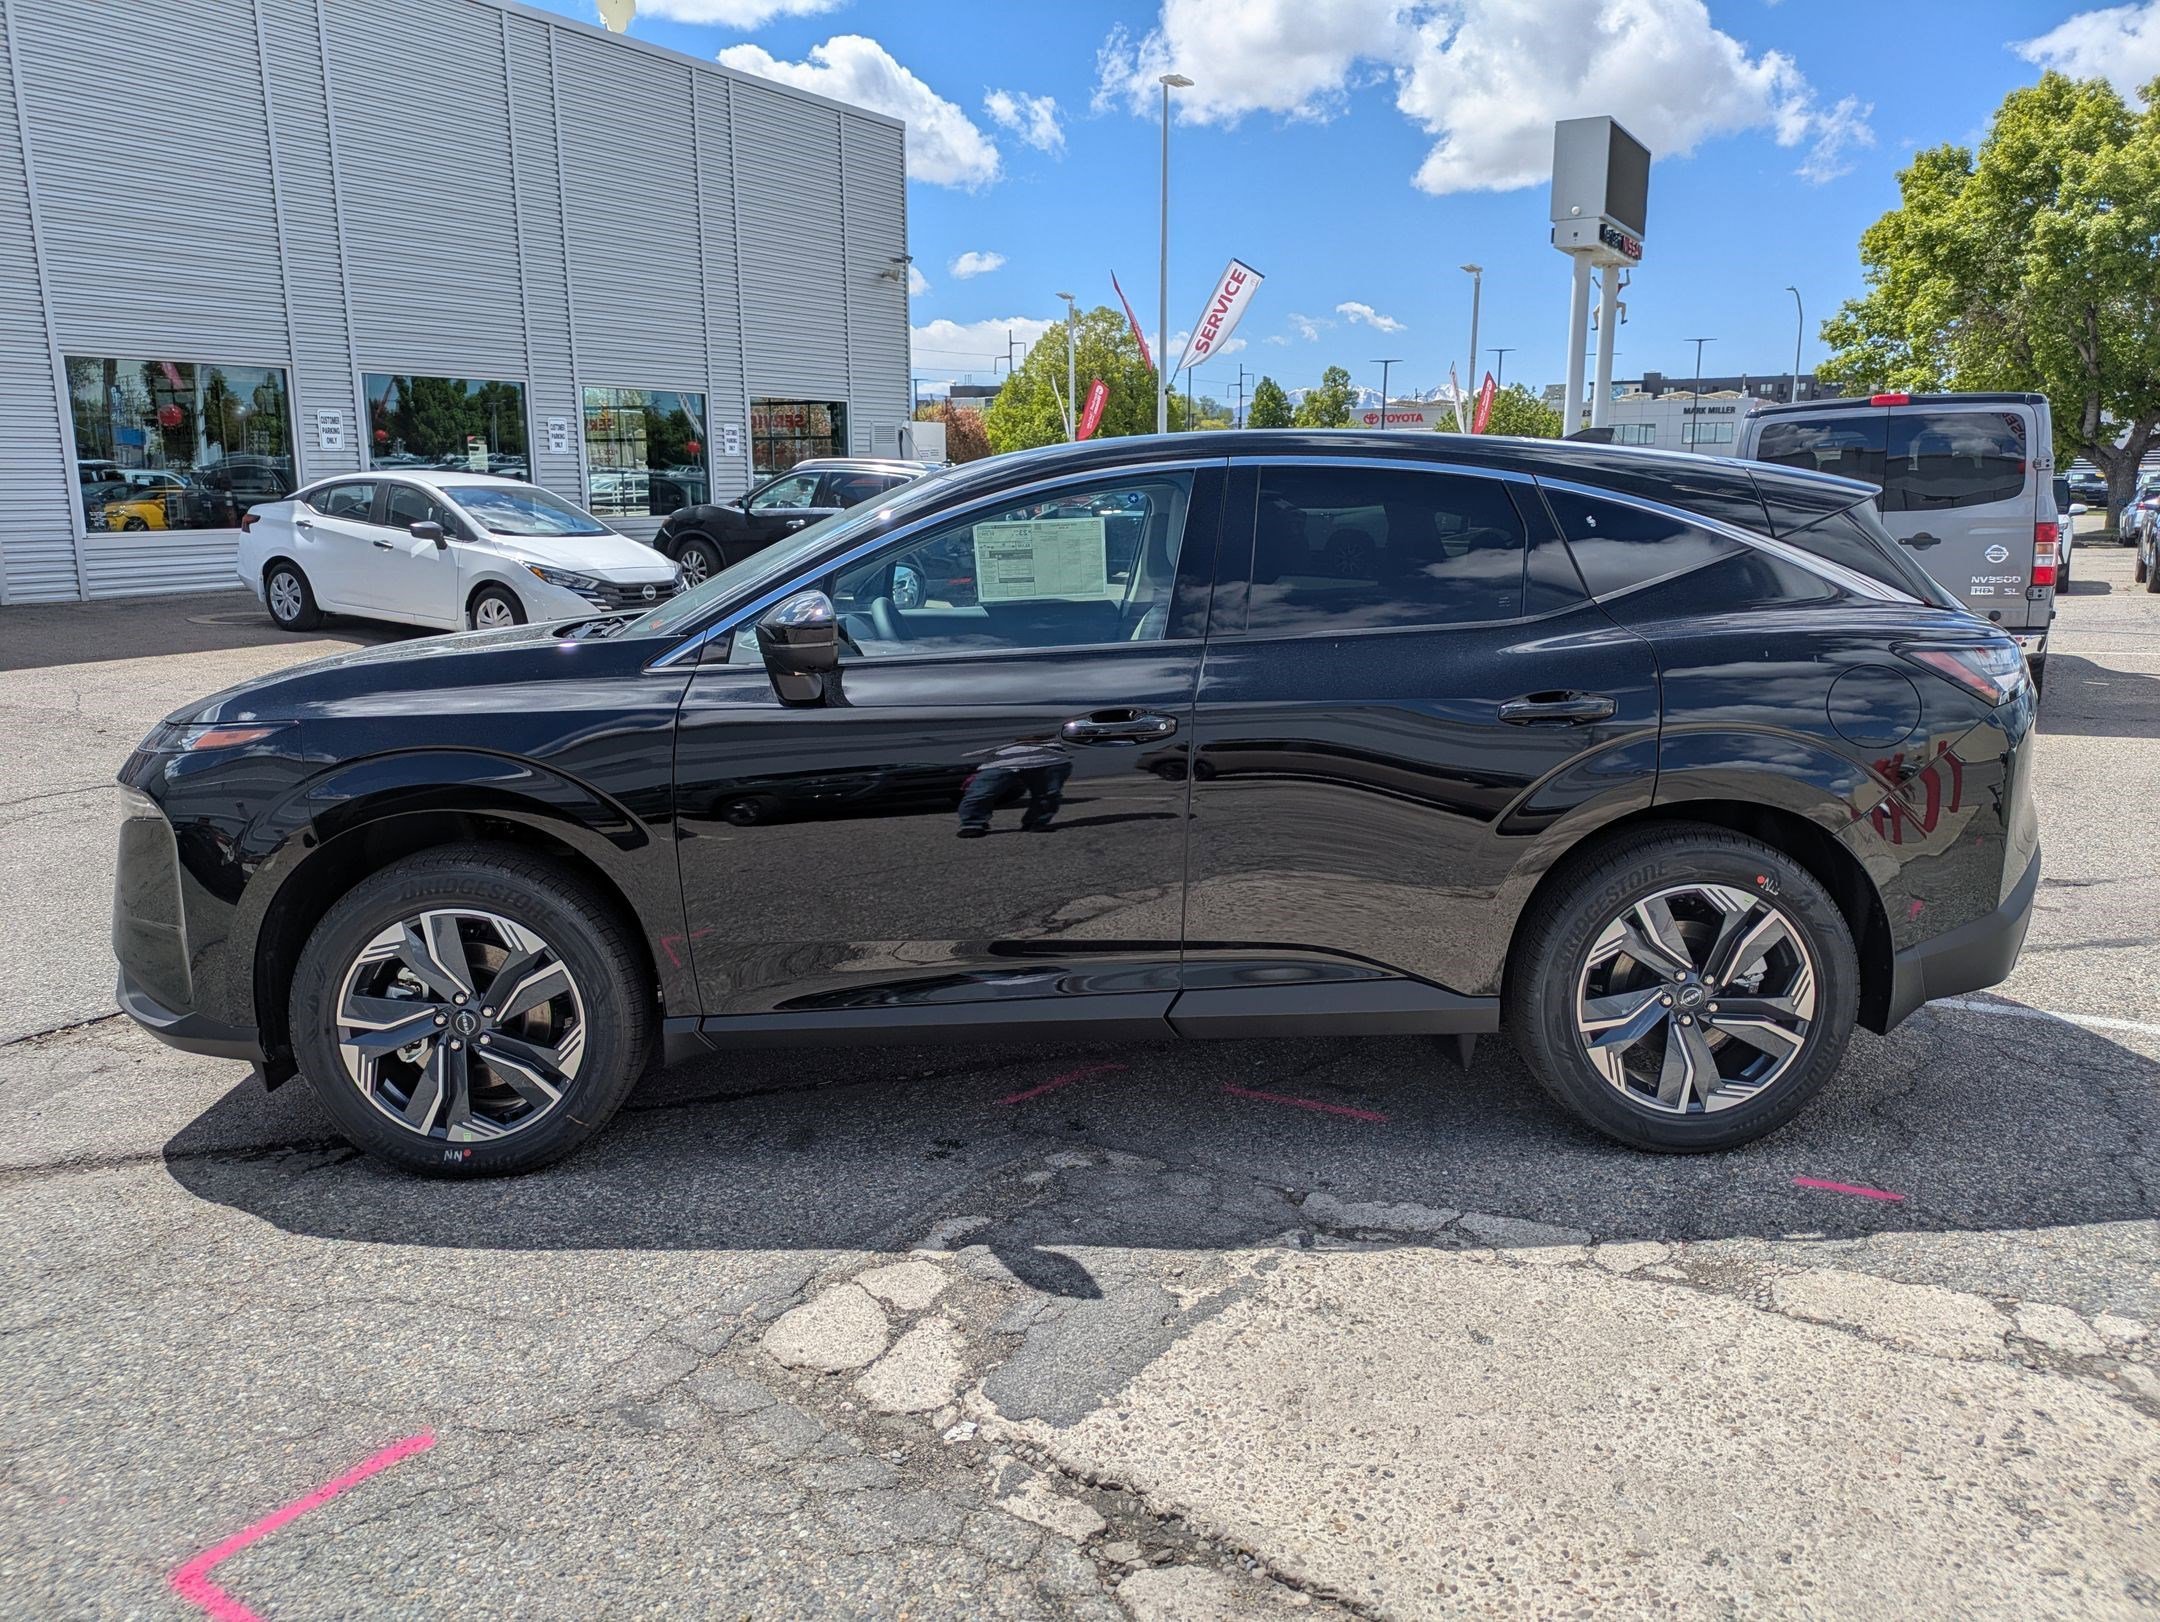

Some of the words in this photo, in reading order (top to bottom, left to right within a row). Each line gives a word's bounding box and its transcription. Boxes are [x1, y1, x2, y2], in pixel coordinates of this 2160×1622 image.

[1195, 268, 1247, 354] SERVICE
[1708, 406, 1736, 414] MILLER
[320, 416, 340, 424] CUSTOMER
[1971, 576, 2021, 584] NV3500
